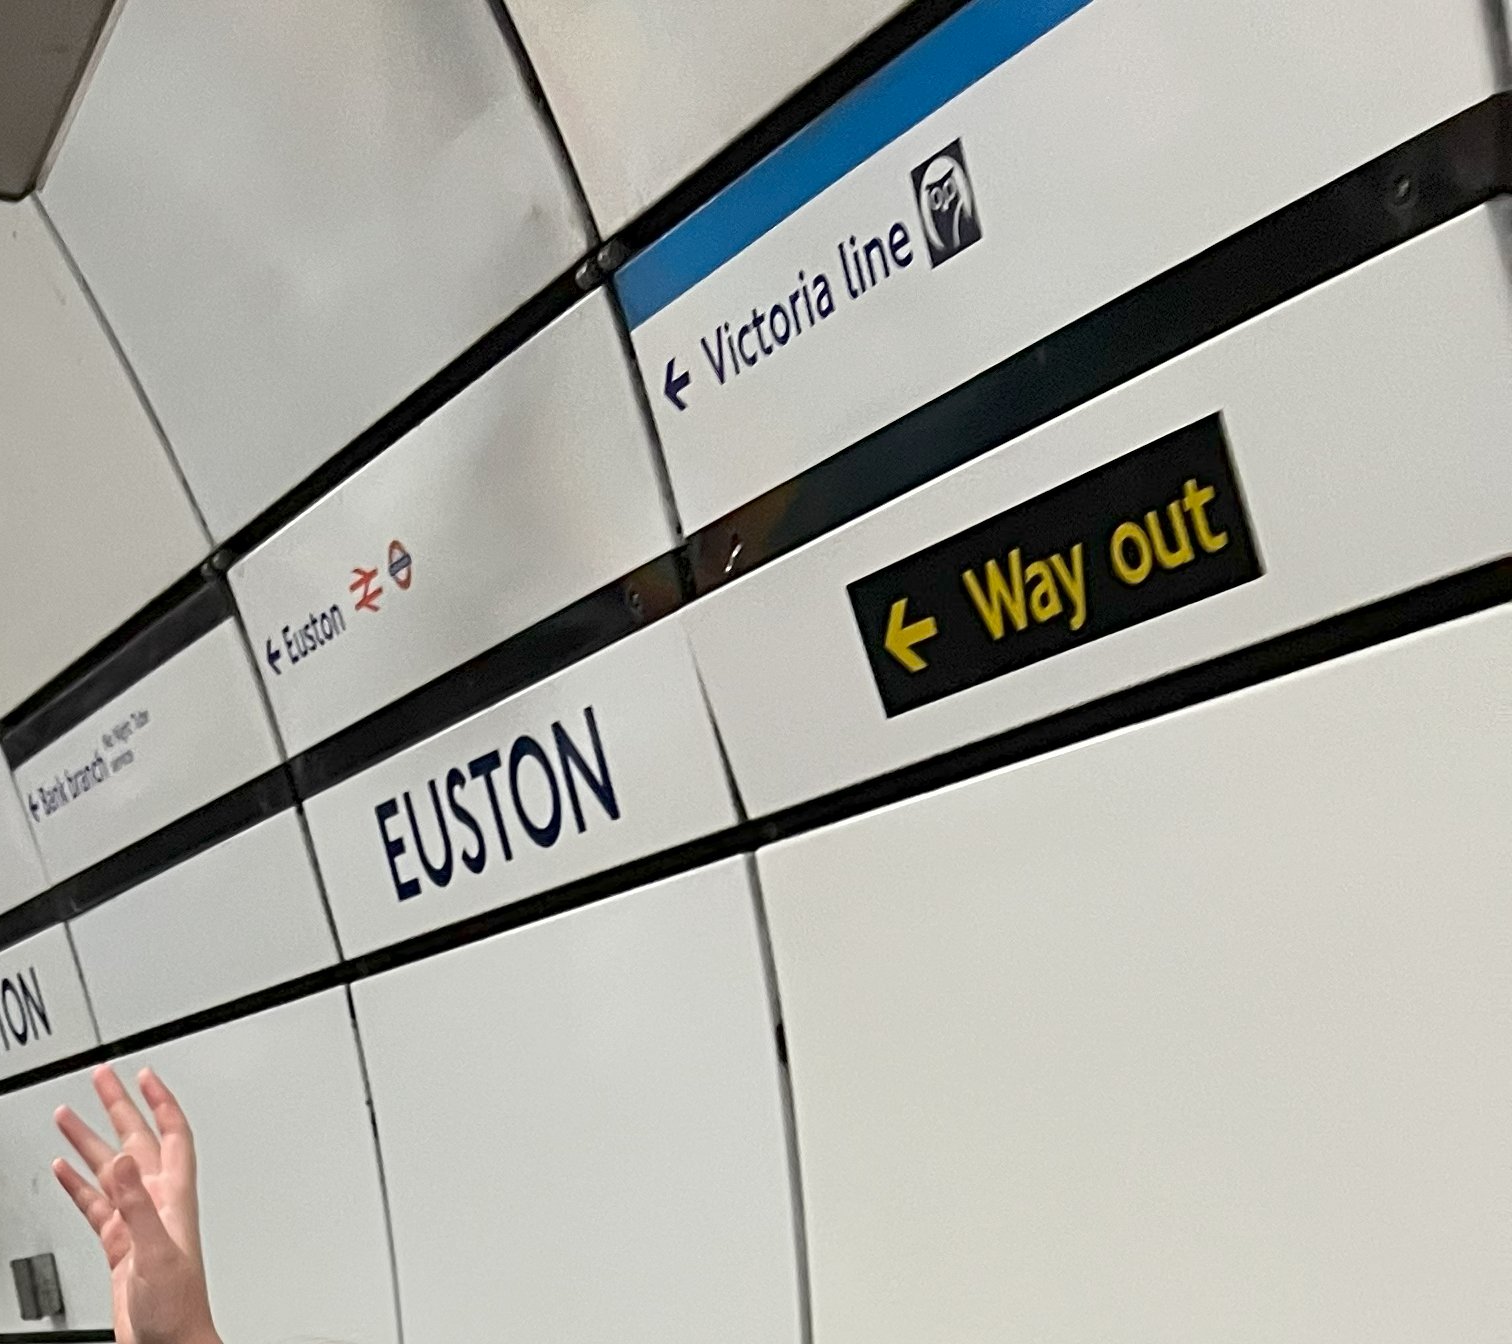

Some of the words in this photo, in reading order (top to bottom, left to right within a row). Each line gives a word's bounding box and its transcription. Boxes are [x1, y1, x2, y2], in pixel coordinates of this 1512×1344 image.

[700, 271, 835, 385] Victoria
[837, 222, 914, 300] line
[282, 604, 346, 664] Euston
[963, 543, 1087, 640] Way
[1110, 479, 1228, 585] out
[375, 706, 621, 902] EUSTON
